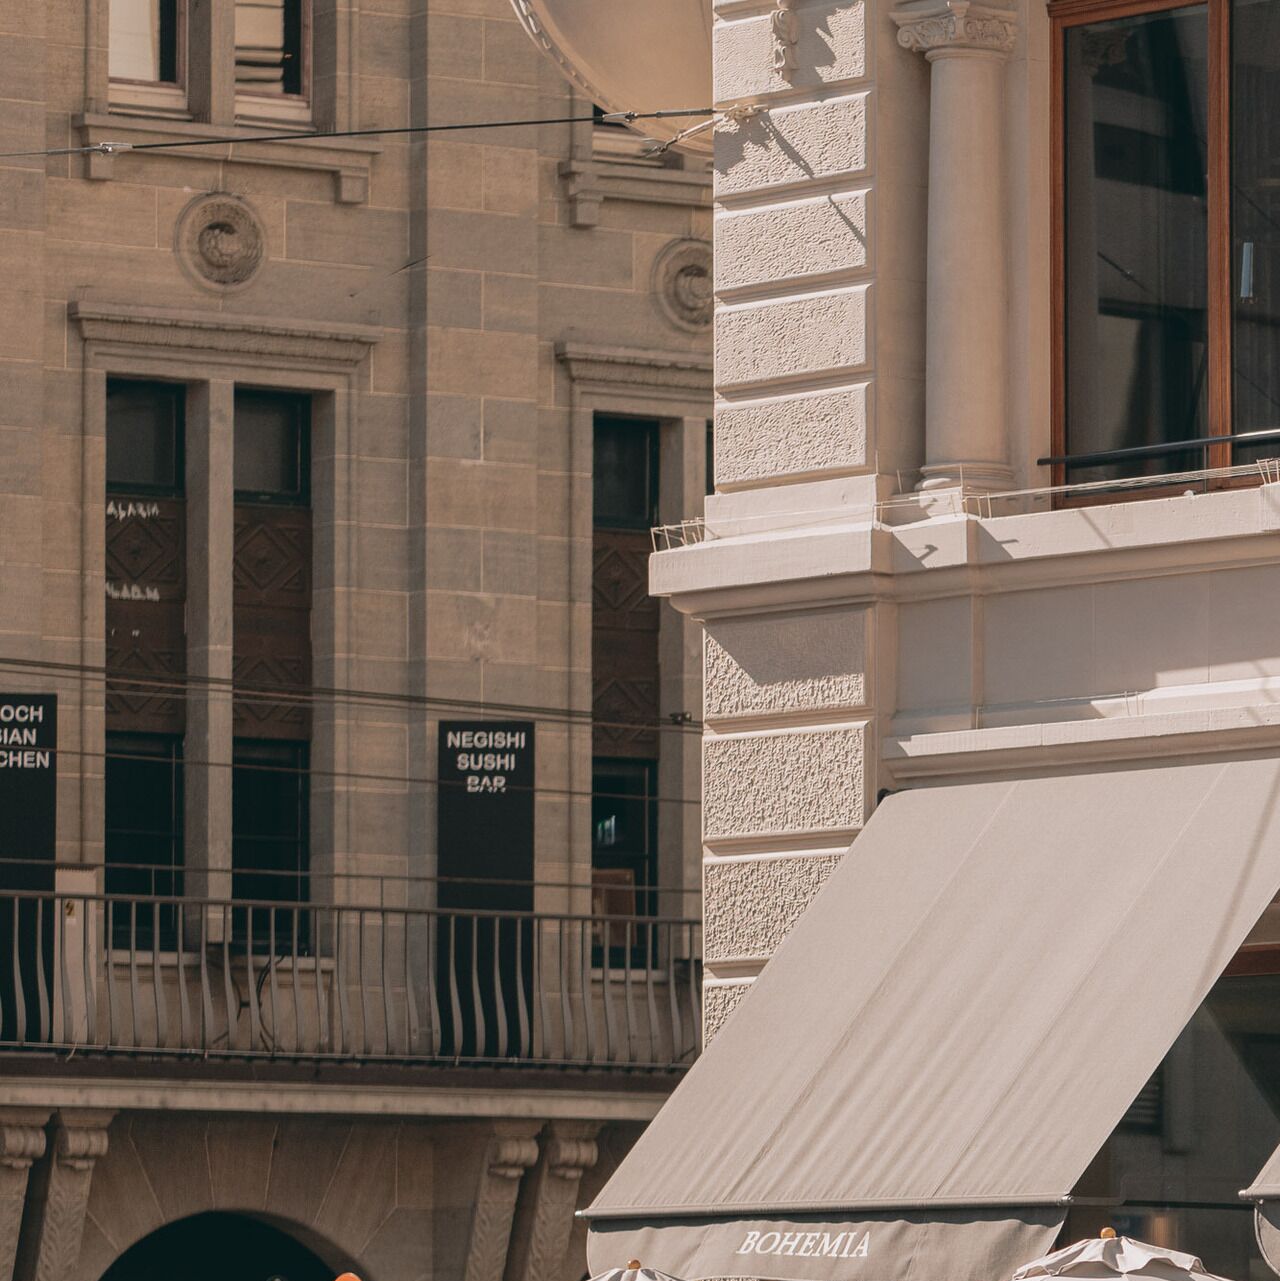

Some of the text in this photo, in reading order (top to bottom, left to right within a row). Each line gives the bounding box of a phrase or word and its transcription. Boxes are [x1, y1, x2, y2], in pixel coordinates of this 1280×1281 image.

[0, 727, 37, 746] IAN
[447, 731, 526, 749] NEGISHI
[457, 753, 516, 771] SUSHI
[466, 775, 507, 793] BAR
[735, 1230, 871, 1258] BOHEMIA
